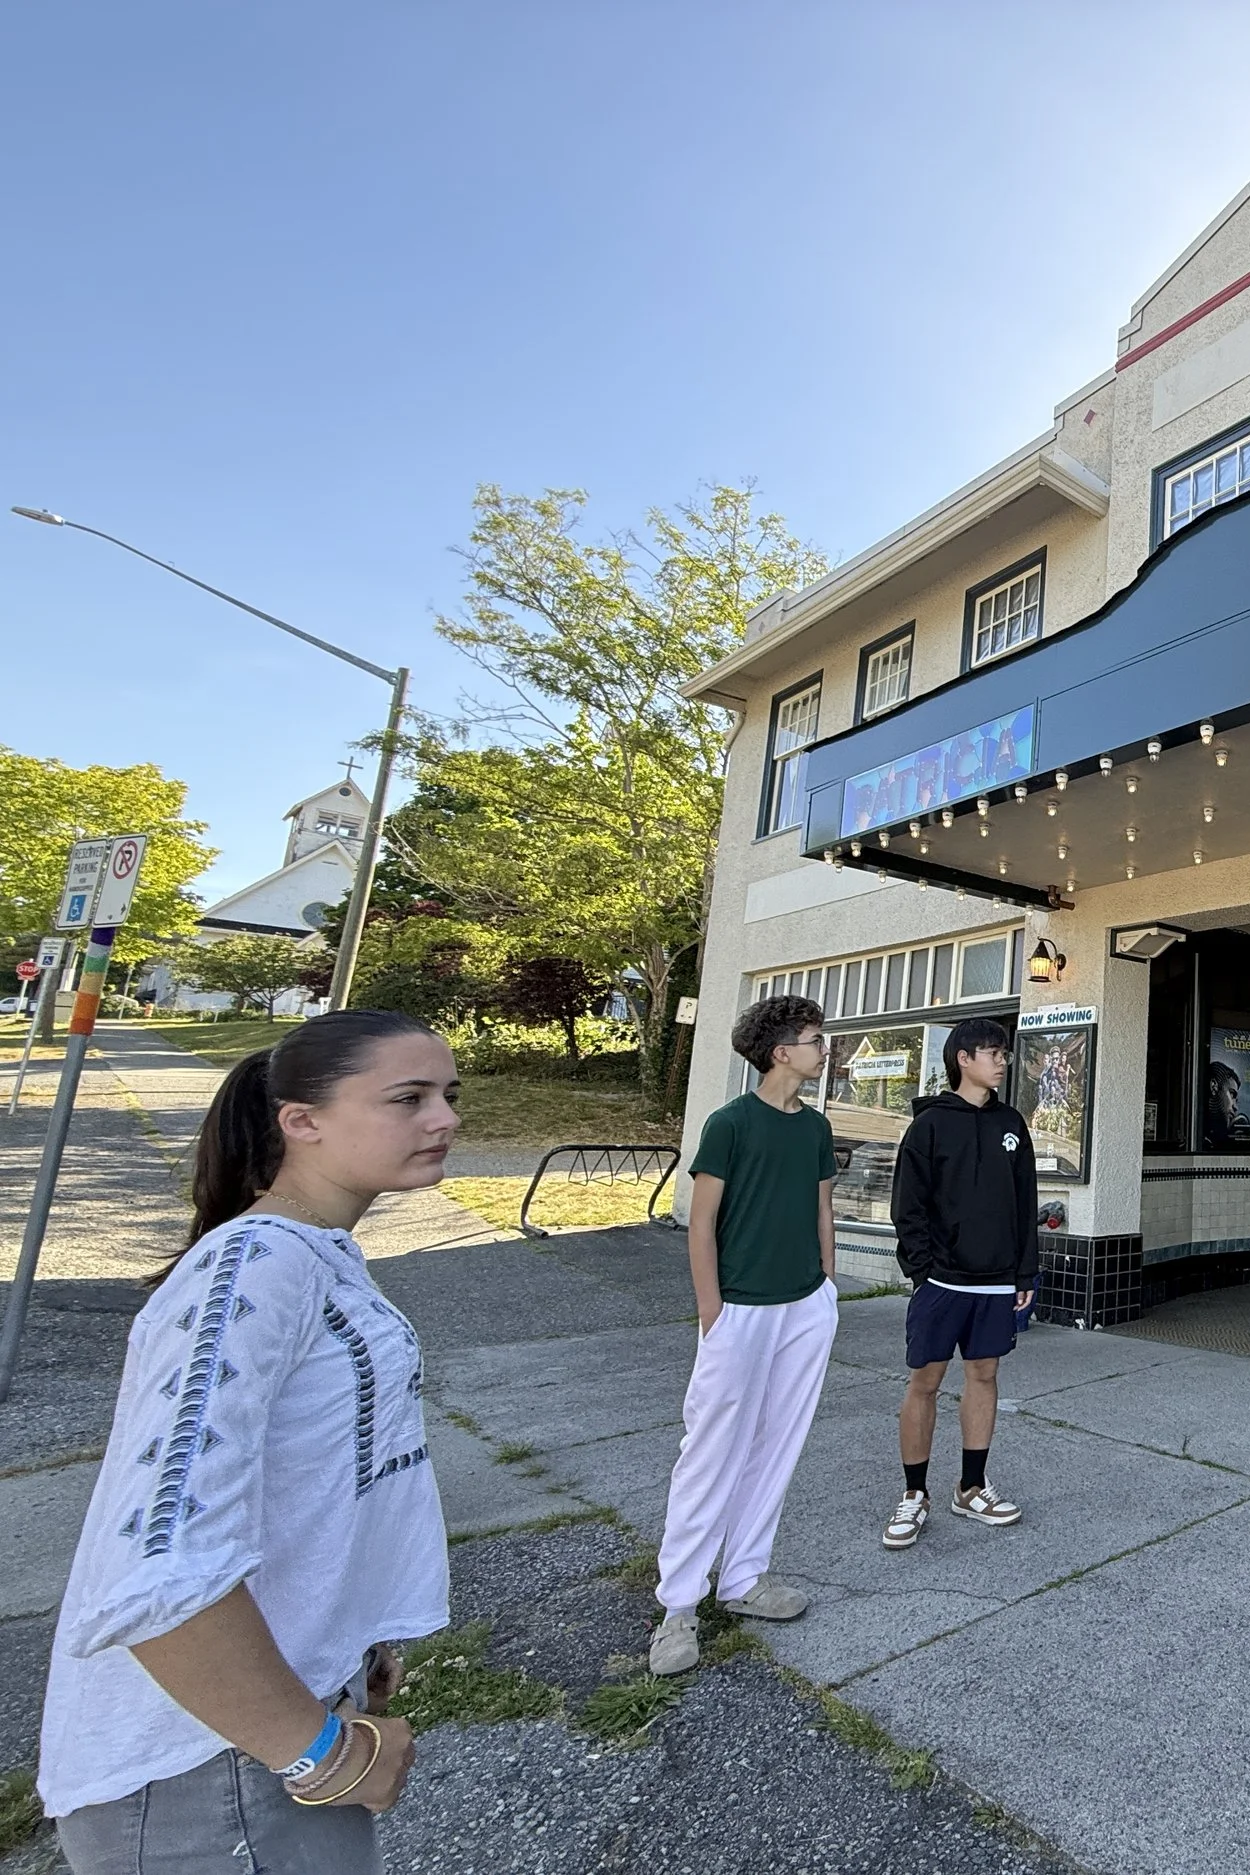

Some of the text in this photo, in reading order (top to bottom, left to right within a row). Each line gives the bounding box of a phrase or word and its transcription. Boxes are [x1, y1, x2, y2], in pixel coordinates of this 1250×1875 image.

[853, 726, 1018, 828] PATRICIA
[19, 965, 39, 973] STOP
[1021, 1009, 1092, 1027] NOW SHOWING
